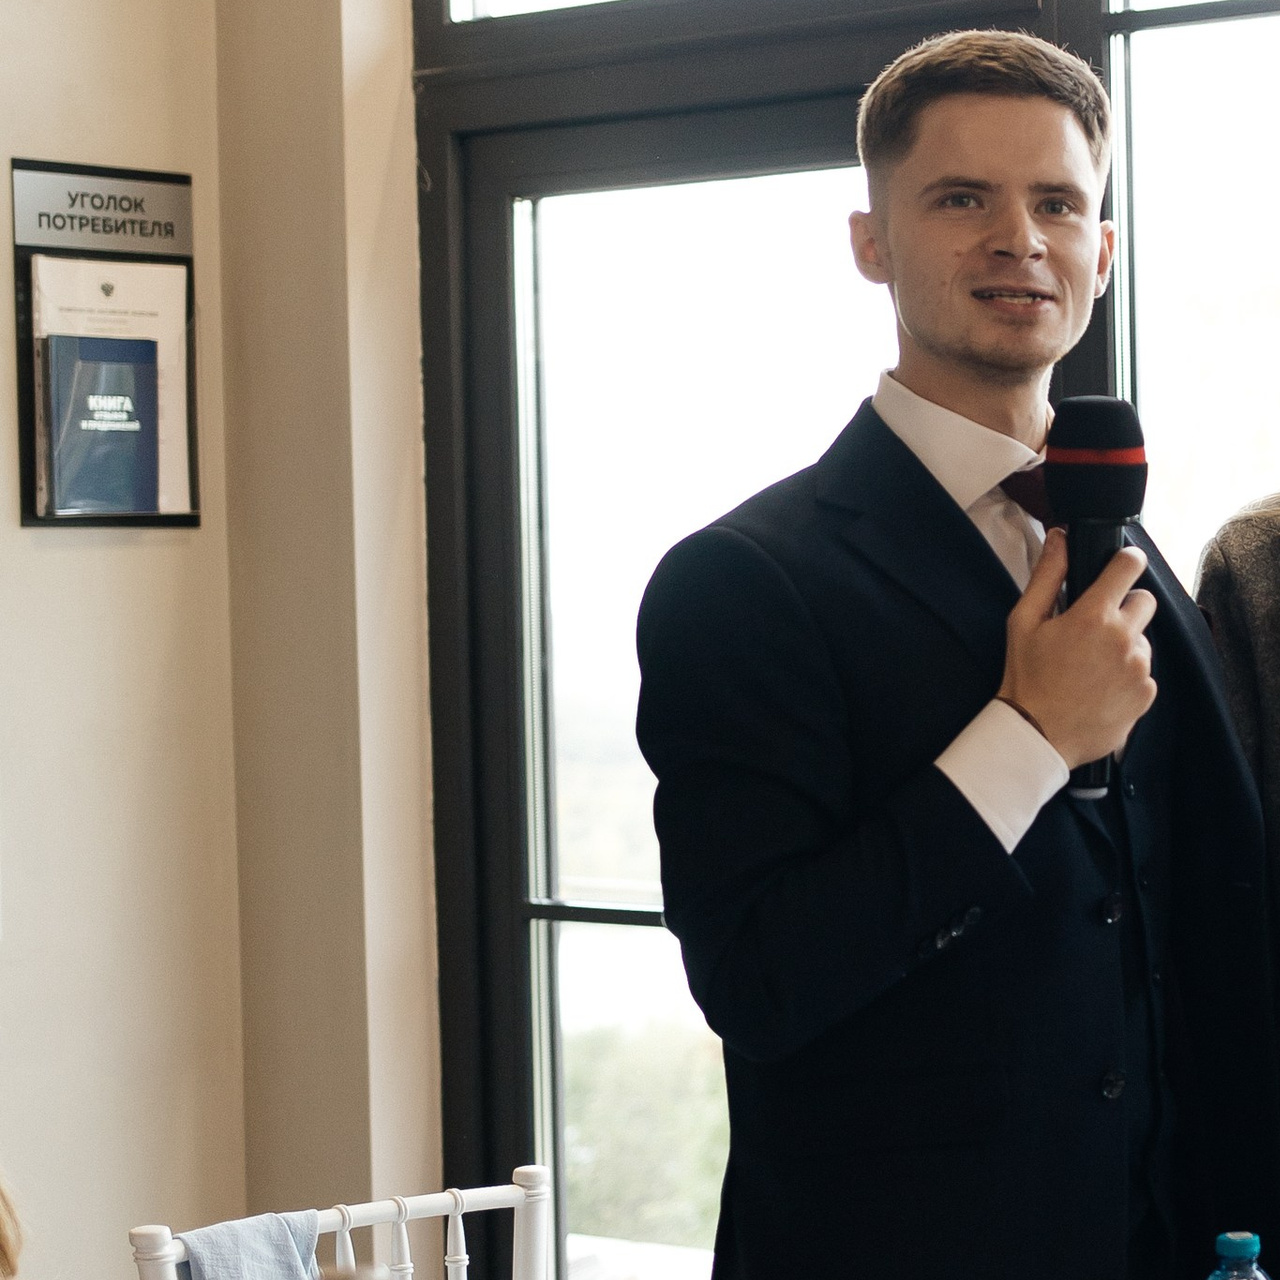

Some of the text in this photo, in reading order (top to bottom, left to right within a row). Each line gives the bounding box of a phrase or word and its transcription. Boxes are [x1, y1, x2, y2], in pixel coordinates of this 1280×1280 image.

[67, 190, 145, 215] УГОЛОК
[38, 211, 175, 238] ПОТРЕБИТЕЛЯ
[88, 394, 135, 412] КНИГА
